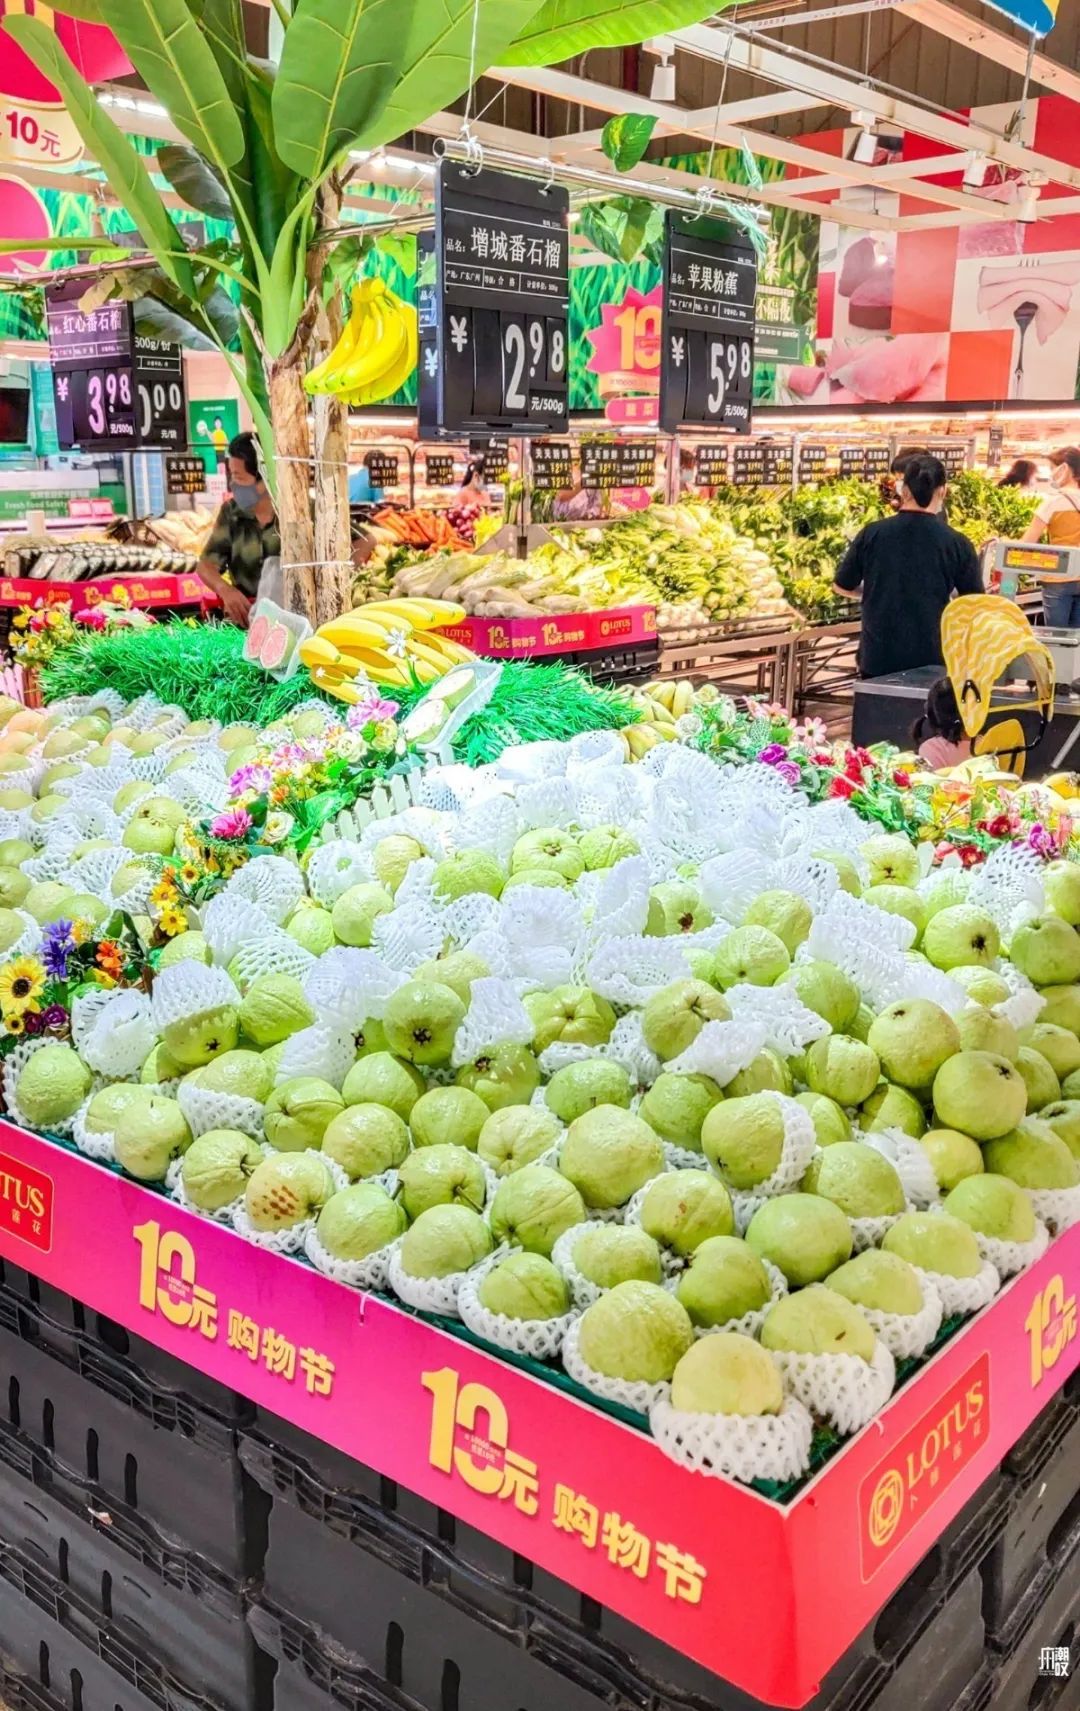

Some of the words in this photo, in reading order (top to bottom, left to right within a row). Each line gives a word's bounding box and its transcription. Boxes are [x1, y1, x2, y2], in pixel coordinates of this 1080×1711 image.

[6, 110, 61, 158] 10元
[471, 227, 561, 269] 增城番石榴
[688, 263, 738, 295] 苹果粉蕉
[505, 322, 564, 409] 2.98
[708, 341, 751, 413] 5.98
[88, 374, 131, 434] 3.98
[531, 396, 564, 414] 元/500g
[724, 404, 748, 419] 元/500g
[446, 628, 472, 639] LOTUS
[133, 1219, 218, 1340] 10元
[226, 1308, 336, 1397] 购物节
[1024, 1273, 1077, 1389] 10元
[906, 1380, 984, 1490] LOTUS
[421, 1366, 539, 1516] 10元
[552, 1482, 708, 1605] 购物节
